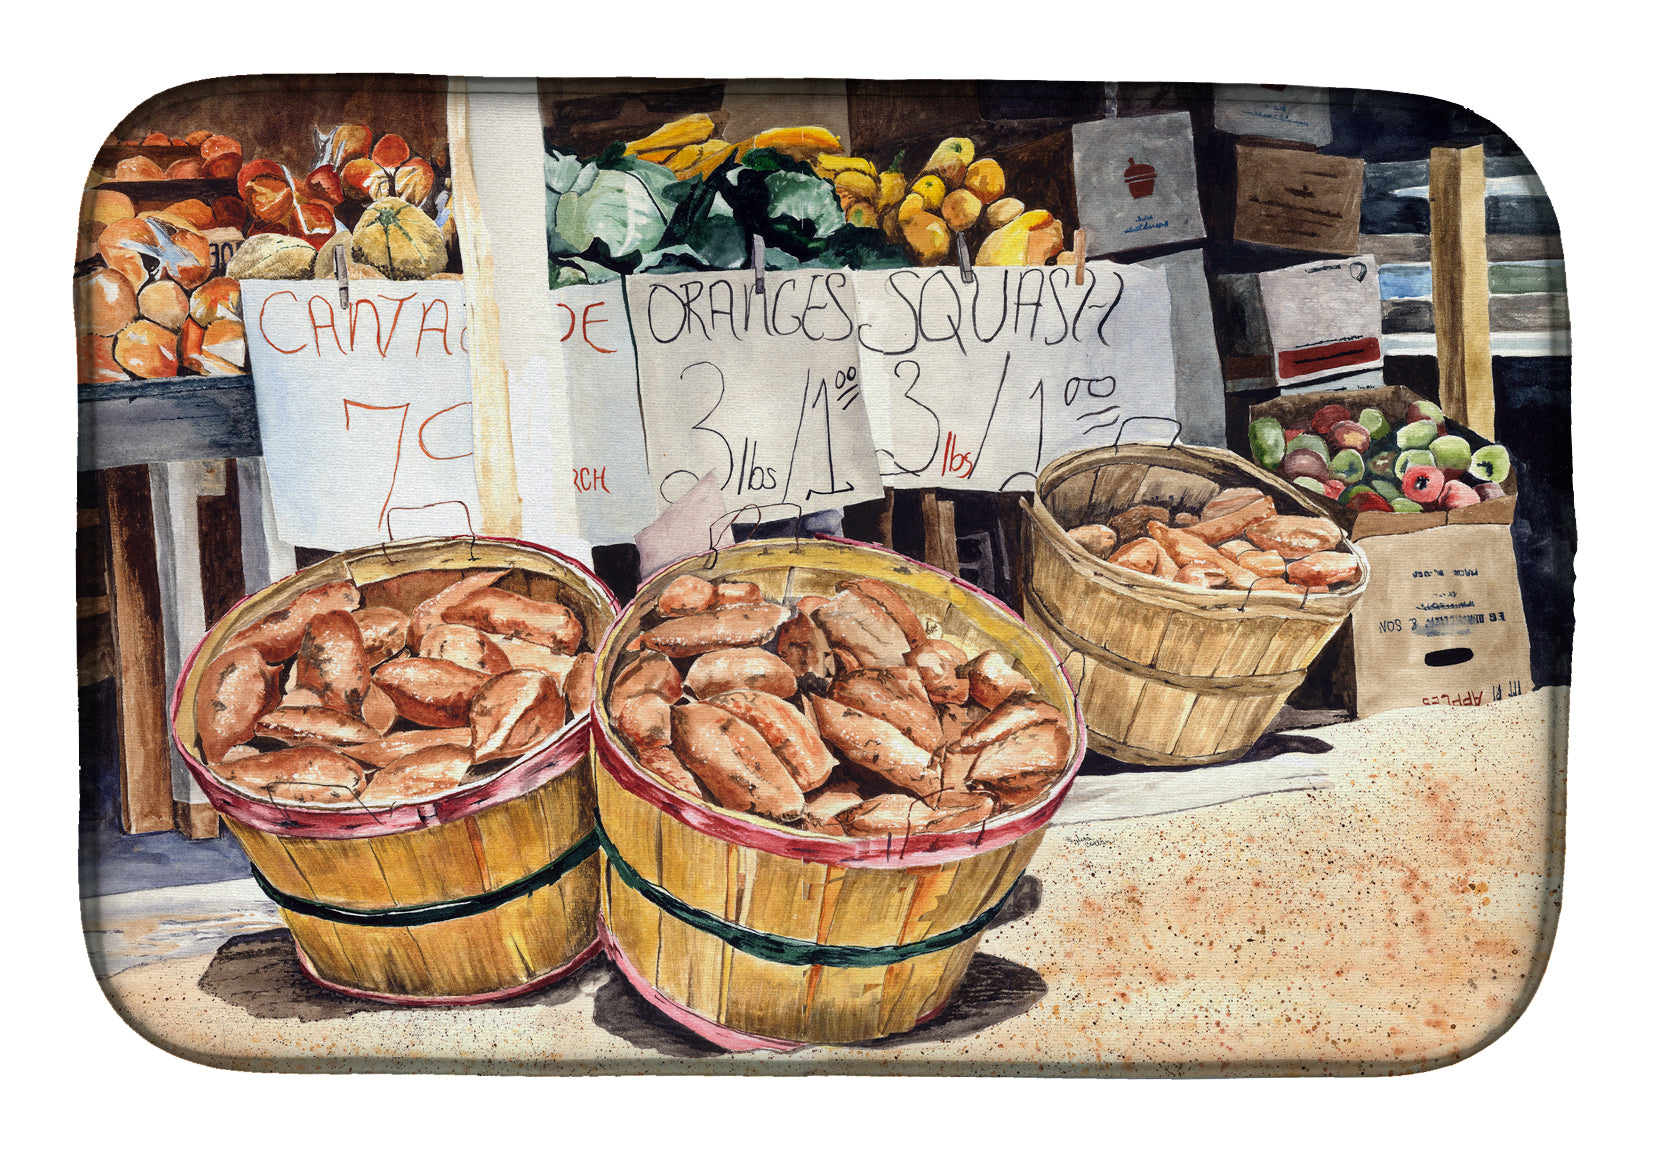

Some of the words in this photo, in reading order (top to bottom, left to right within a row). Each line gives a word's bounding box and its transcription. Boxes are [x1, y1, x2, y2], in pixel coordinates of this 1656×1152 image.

[259, 290, 468, 358] CANTA
[648, 272, 853, 344] ORANGES
[858, 267, 1124, 357] SQUASH
[1379, 618, 1402, 634] SON
